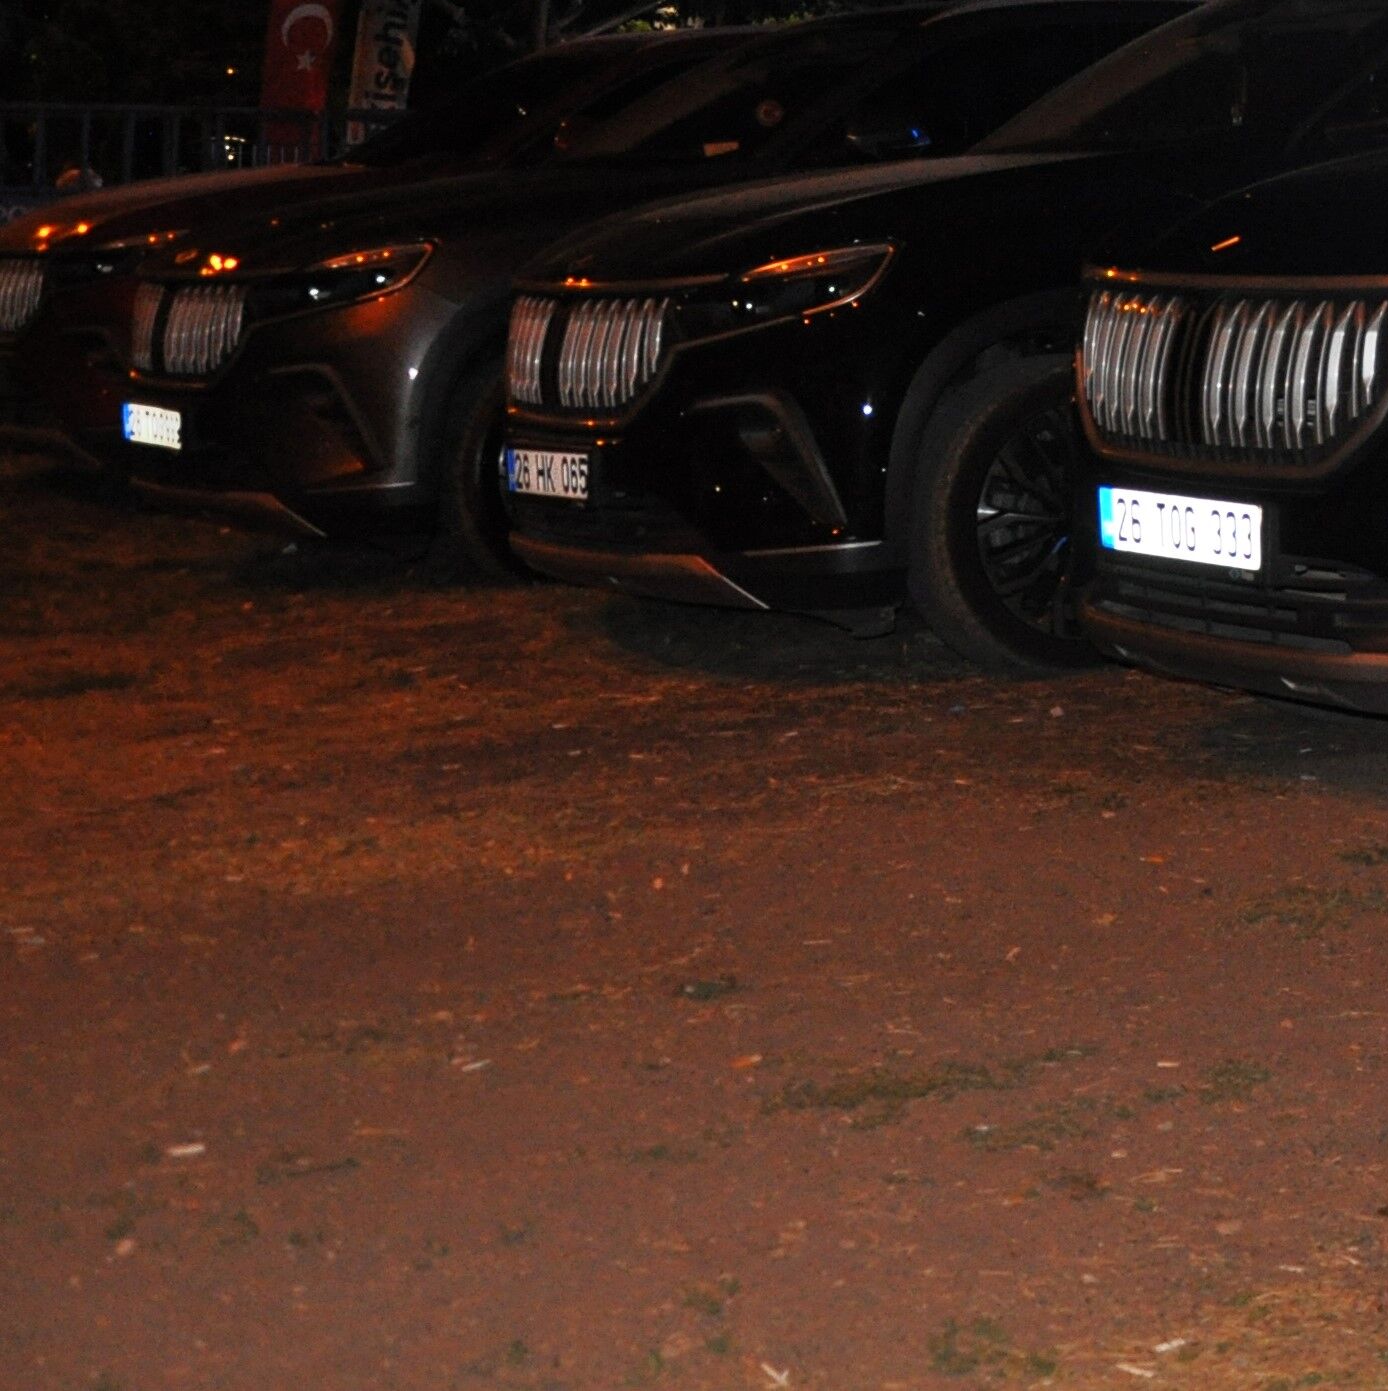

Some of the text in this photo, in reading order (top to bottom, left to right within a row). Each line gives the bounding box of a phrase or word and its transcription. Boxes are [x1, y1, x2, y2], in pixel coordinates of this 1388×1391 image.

[515, 453, 588, 495] 26 HK 065
[1116, 498, 1253, 560] 26 TOG 333
